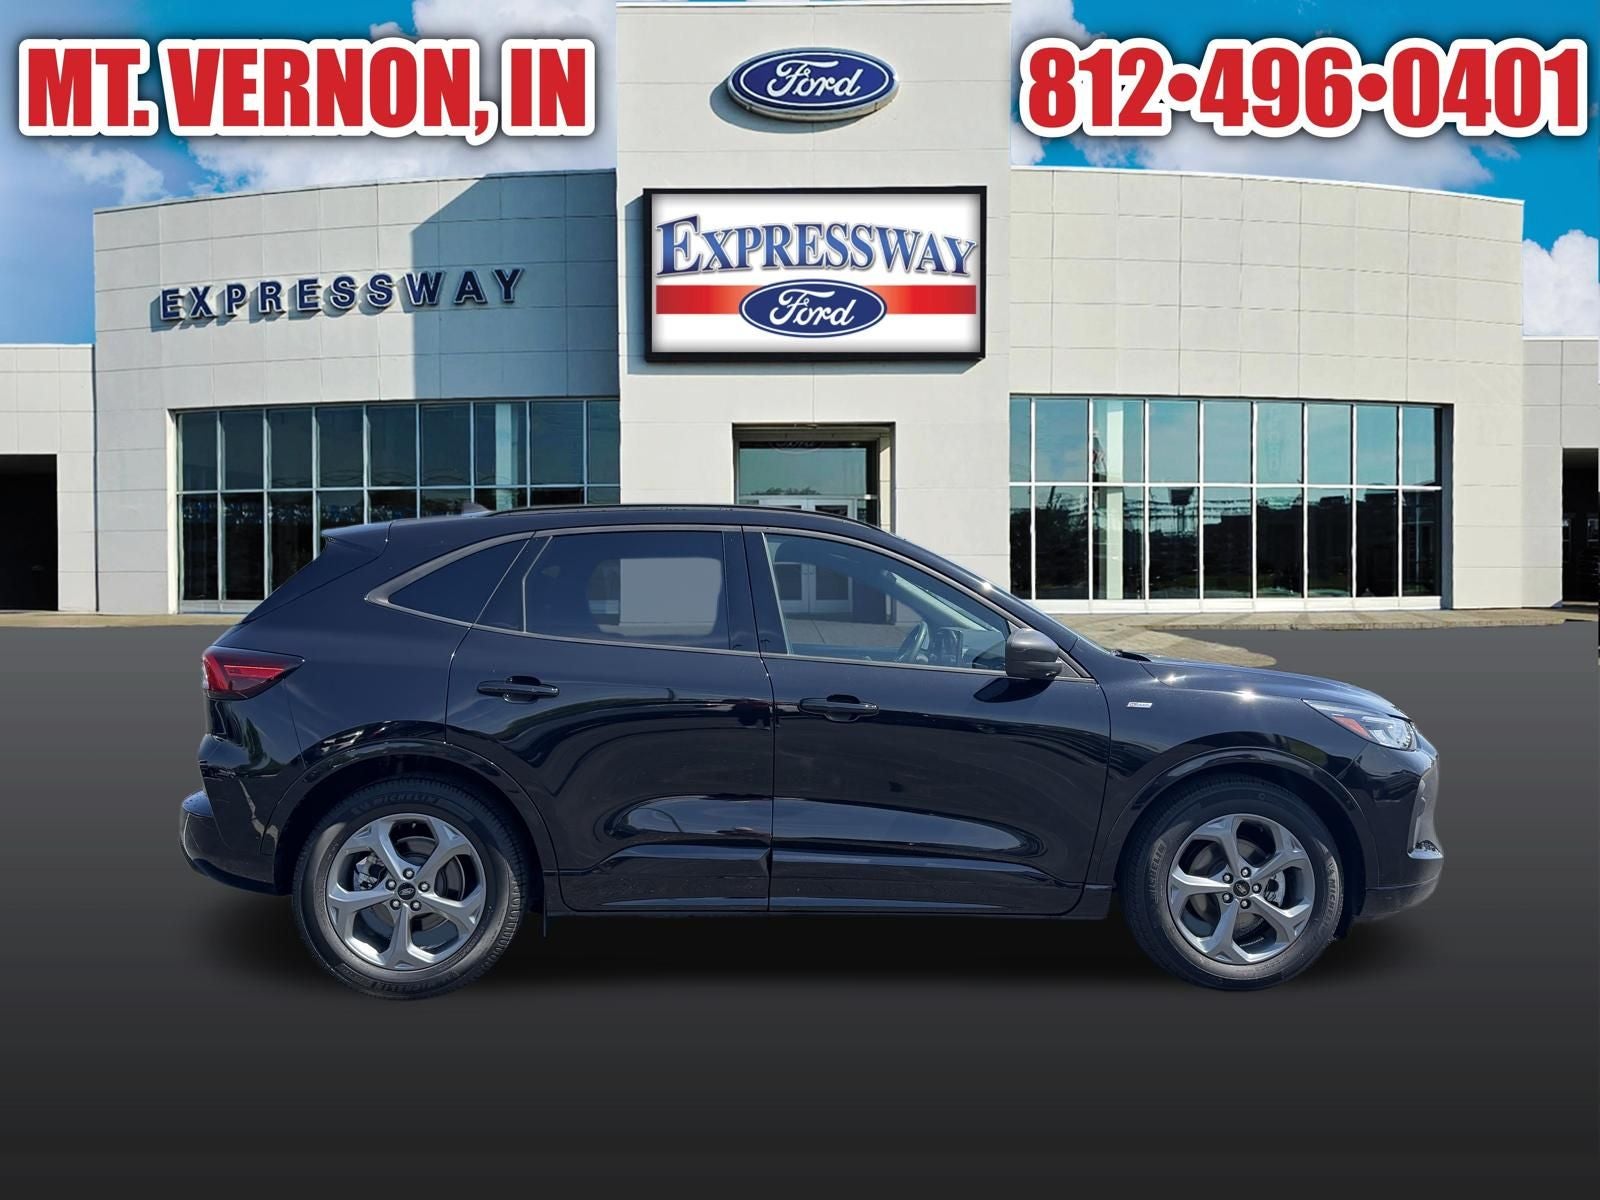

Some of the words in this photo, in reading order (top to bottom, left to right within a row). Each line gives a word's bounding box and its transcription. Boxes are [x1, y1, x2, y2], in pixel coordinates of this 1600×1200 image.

[766, 59, 864, 98] Ford
[655, 213, 977, 278] EXPRESSWAY
[159, 267, 525, 321] EXPRESSWAY
[768, 287, 857, 327] Ford
